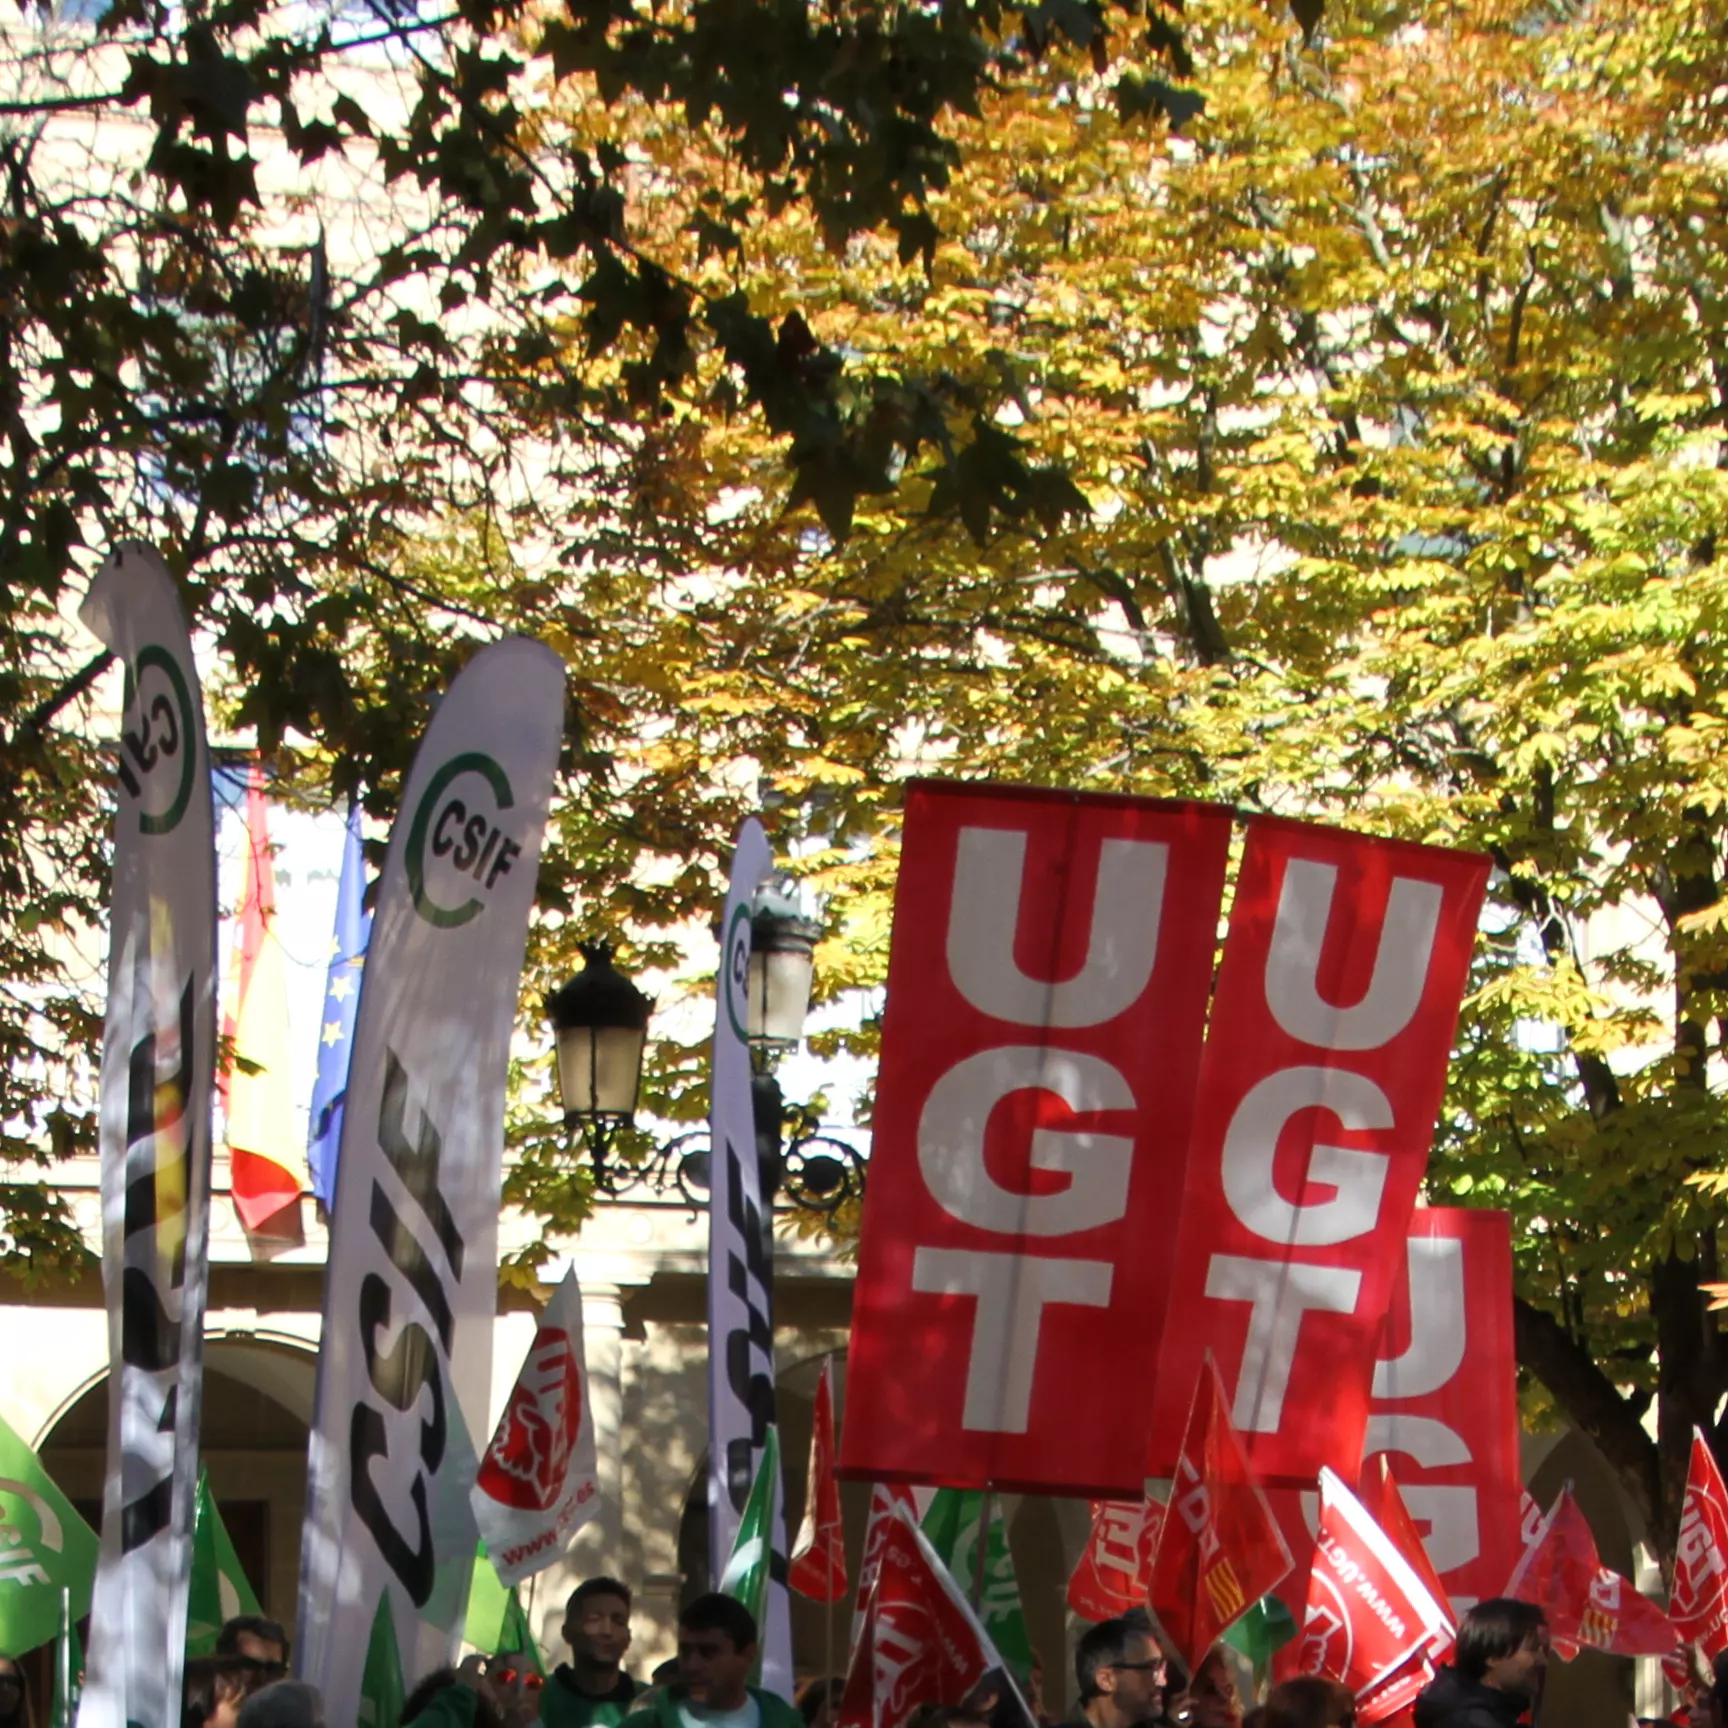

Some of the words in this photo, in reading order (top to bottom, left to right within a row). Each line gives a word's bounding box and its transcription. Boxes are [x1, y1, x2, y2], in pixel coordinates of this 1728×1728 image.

[432, 798, 522, 890] CSIF
[351, 1047, 465, 1610] CSIF
[912, 826, 1171, 1435] UGT
[1204, 857, 1444, 1434] UGT
